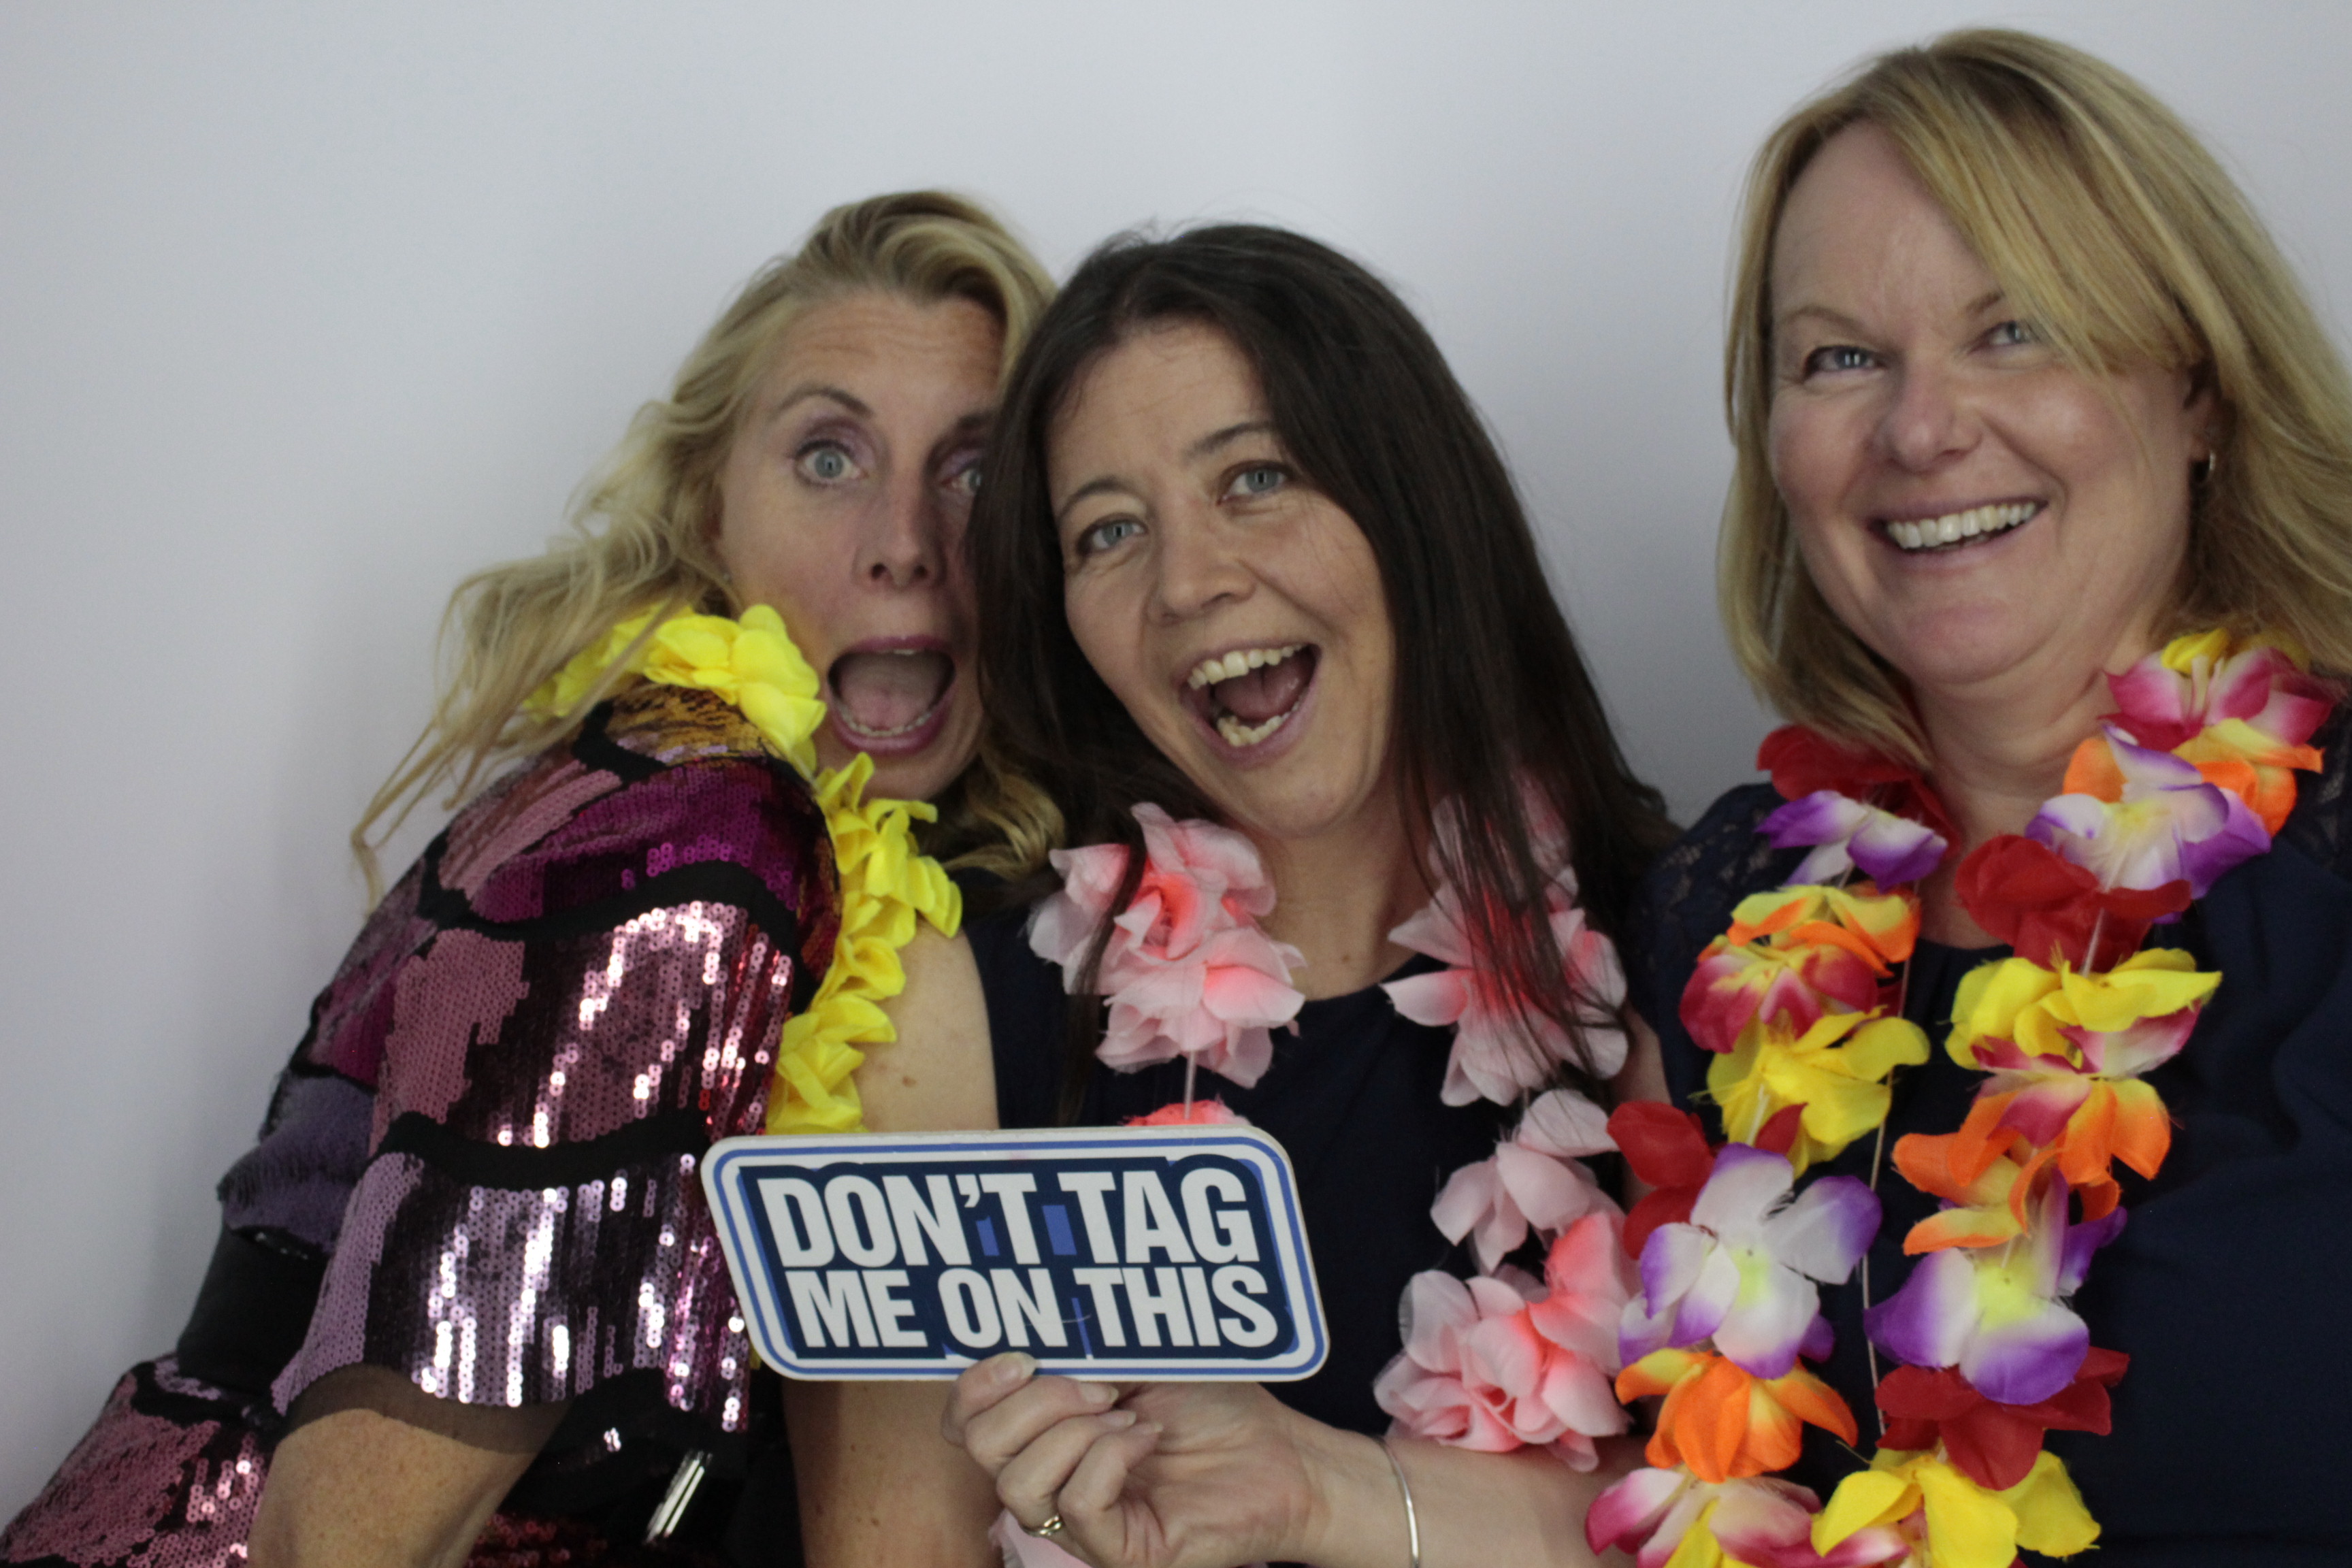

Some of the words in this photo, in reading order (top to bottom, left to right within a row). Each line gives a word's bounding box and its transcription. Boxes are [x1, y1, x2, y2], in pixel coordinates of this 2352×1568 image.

[757, 1173, 1041, 1267] DON'T
[1060, 1168, 1260, 1264] TAG
[785, 1269, 928, 1348] ME
[938, 1268, 1068, 1349] ON
[1073, 1266, 1278, 1348] THIS
